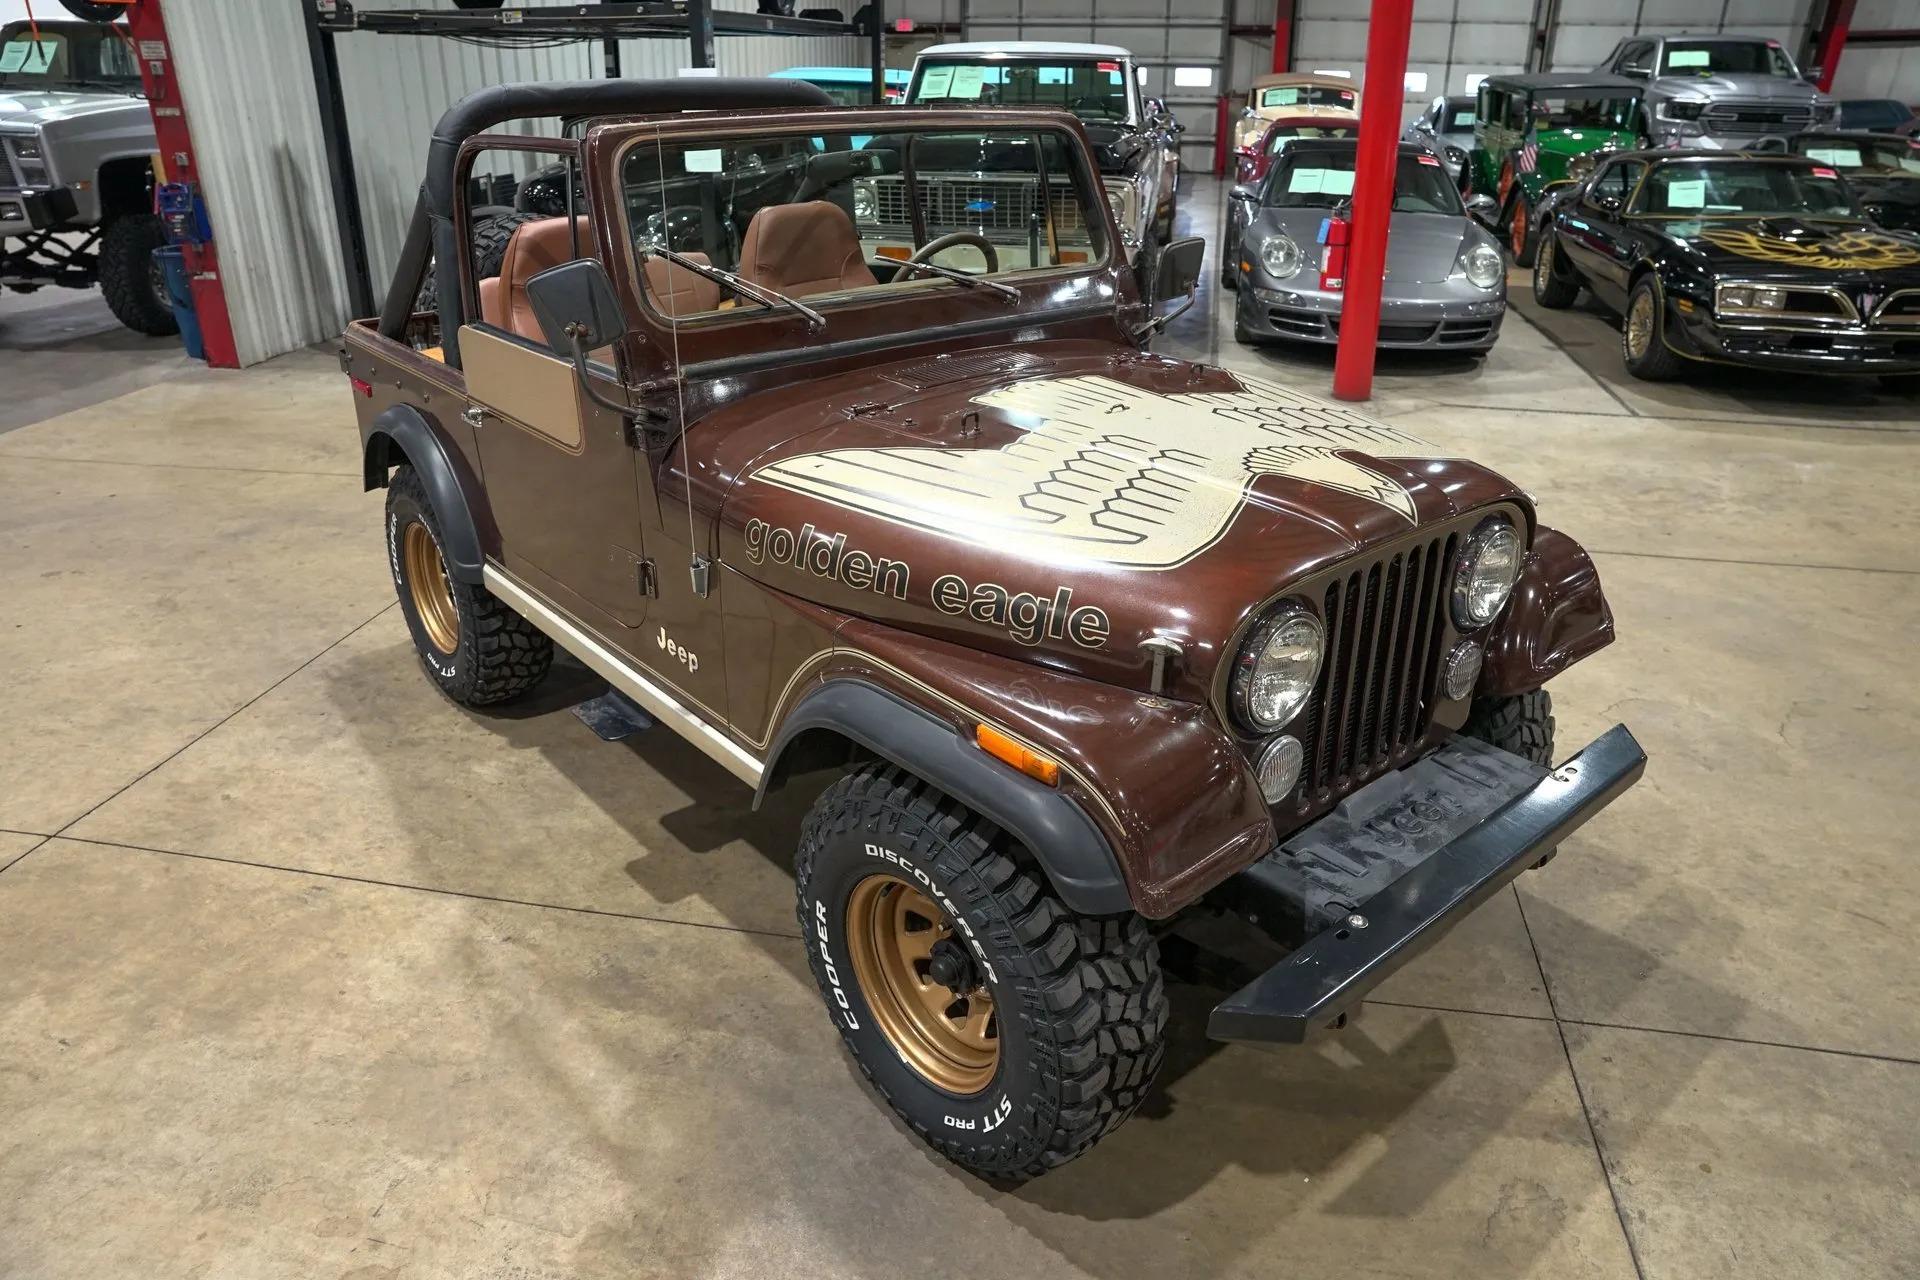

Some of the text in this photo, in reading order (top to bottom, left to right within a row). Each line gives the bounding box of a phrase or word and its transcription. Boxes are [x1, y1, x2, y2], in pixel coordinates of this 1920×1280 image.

[744, 517, 1110, 648] golden eagle
[656, 626, 699, 673] Jeep
[815, 900, 860, 1030] COOPER
[864, 843, 999, 985] DISCOVERER
[943, 1093, 1012, 1133] STT PRO
